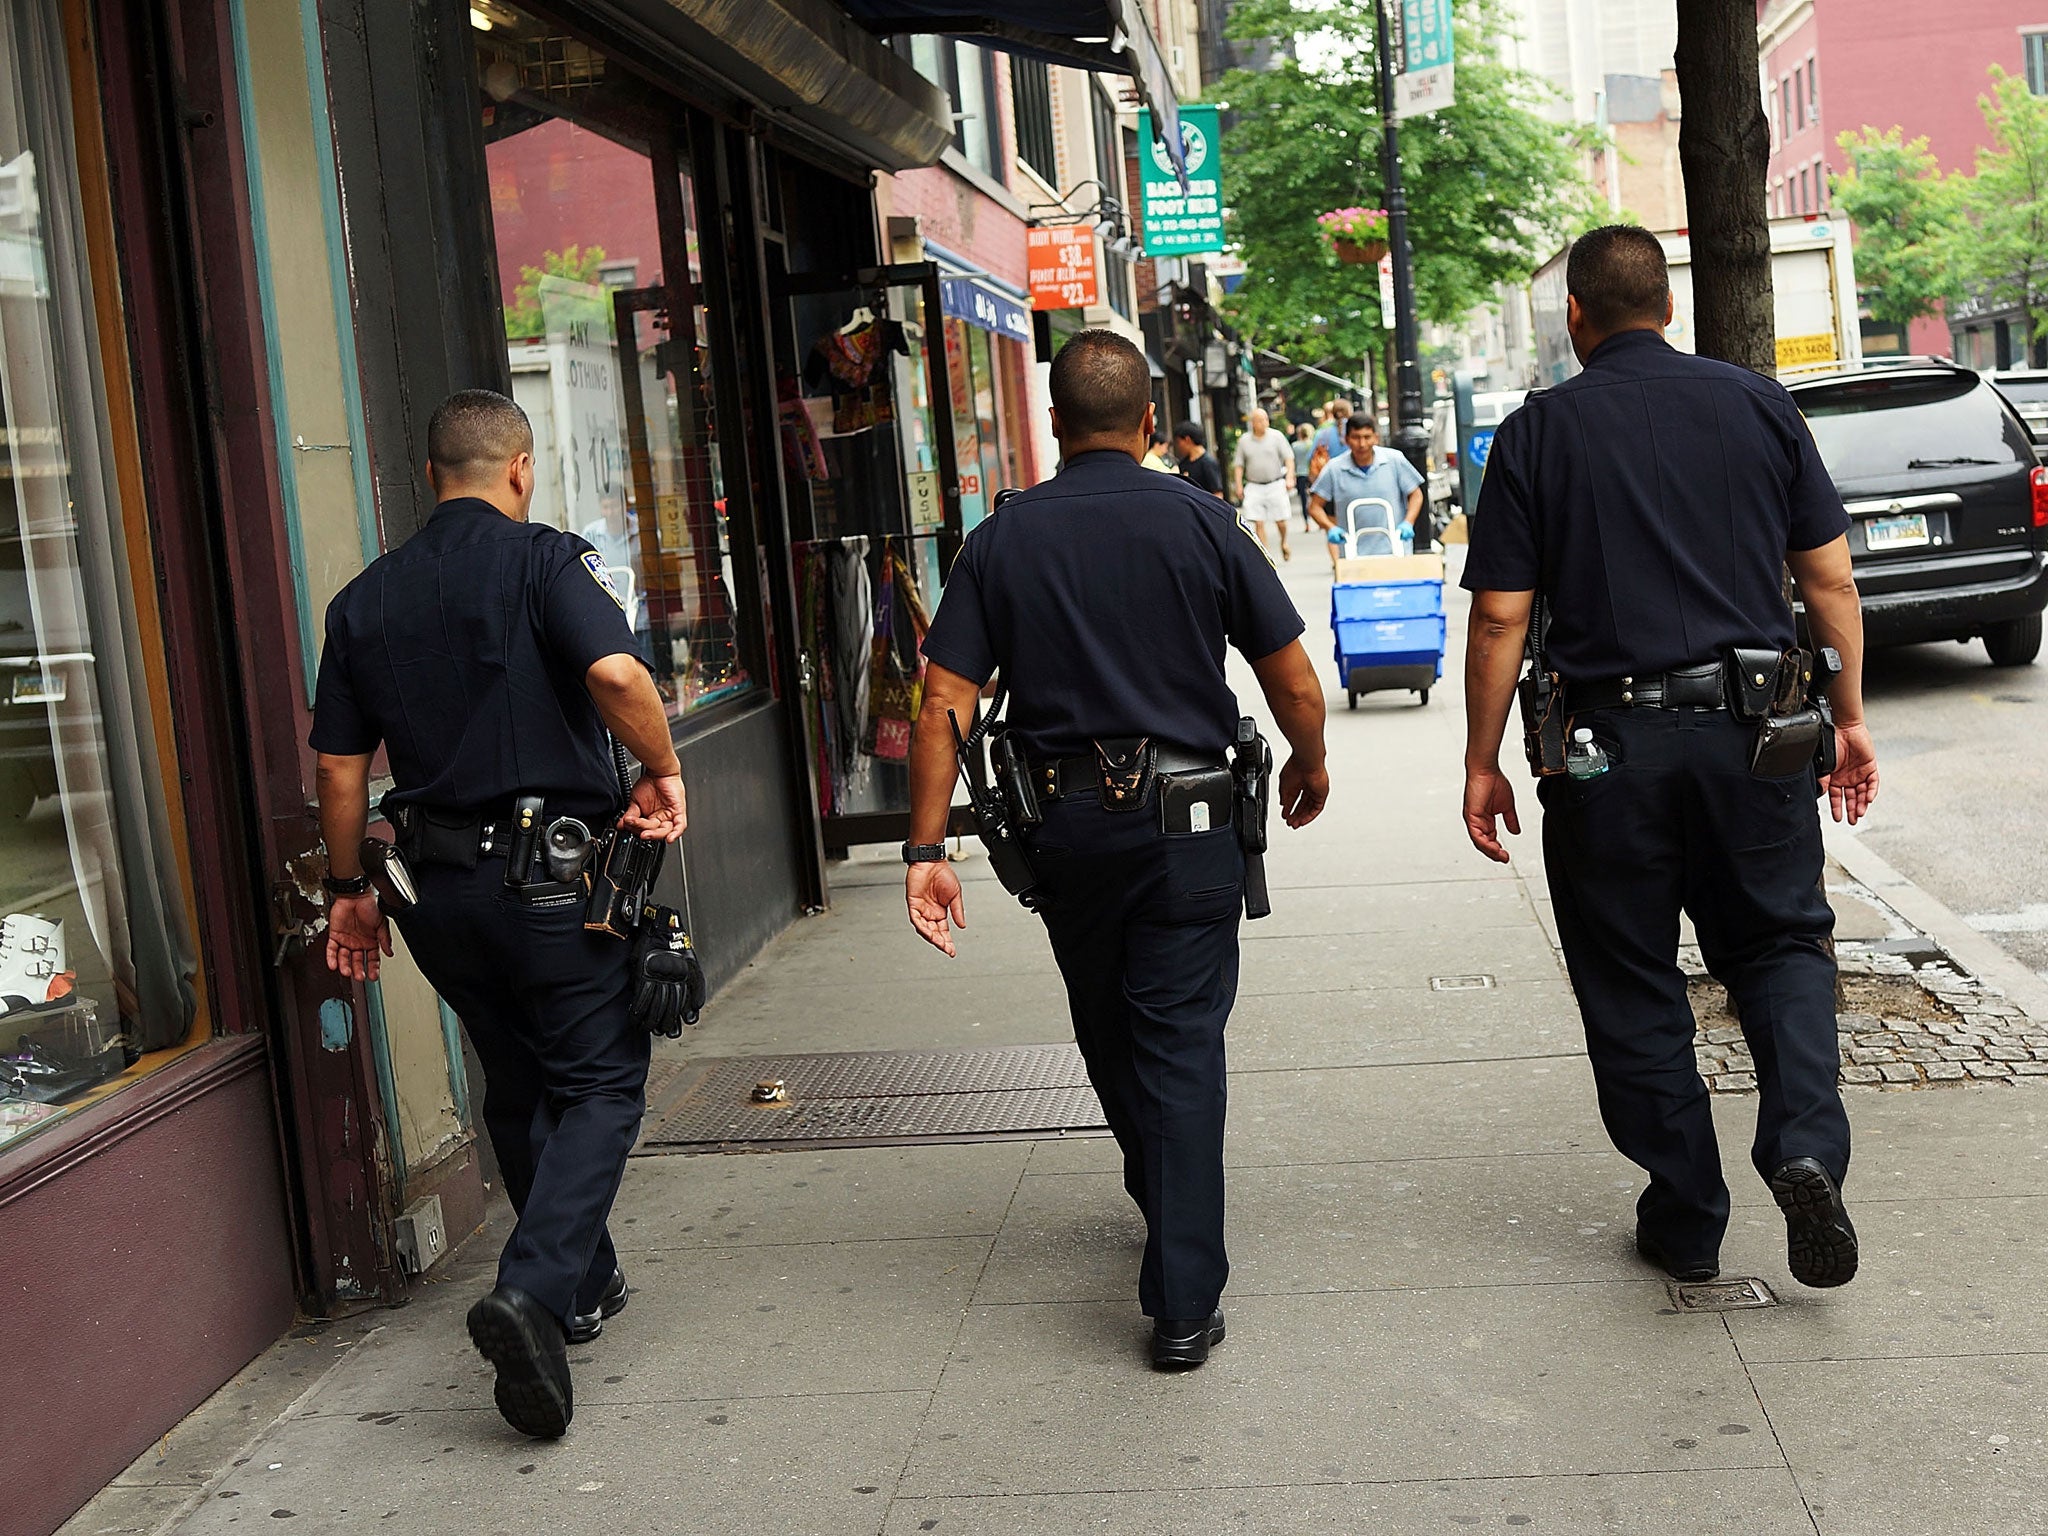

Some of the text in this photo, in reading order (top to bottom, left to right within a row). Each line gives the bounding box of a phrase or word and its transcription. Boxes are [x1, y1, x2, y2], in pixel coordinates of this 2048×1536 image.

[1147, 198, 1218, 216] FOOT RUB
[570, 320, 589, 349] ANY
[916, 475, 931, 522] PUSH
